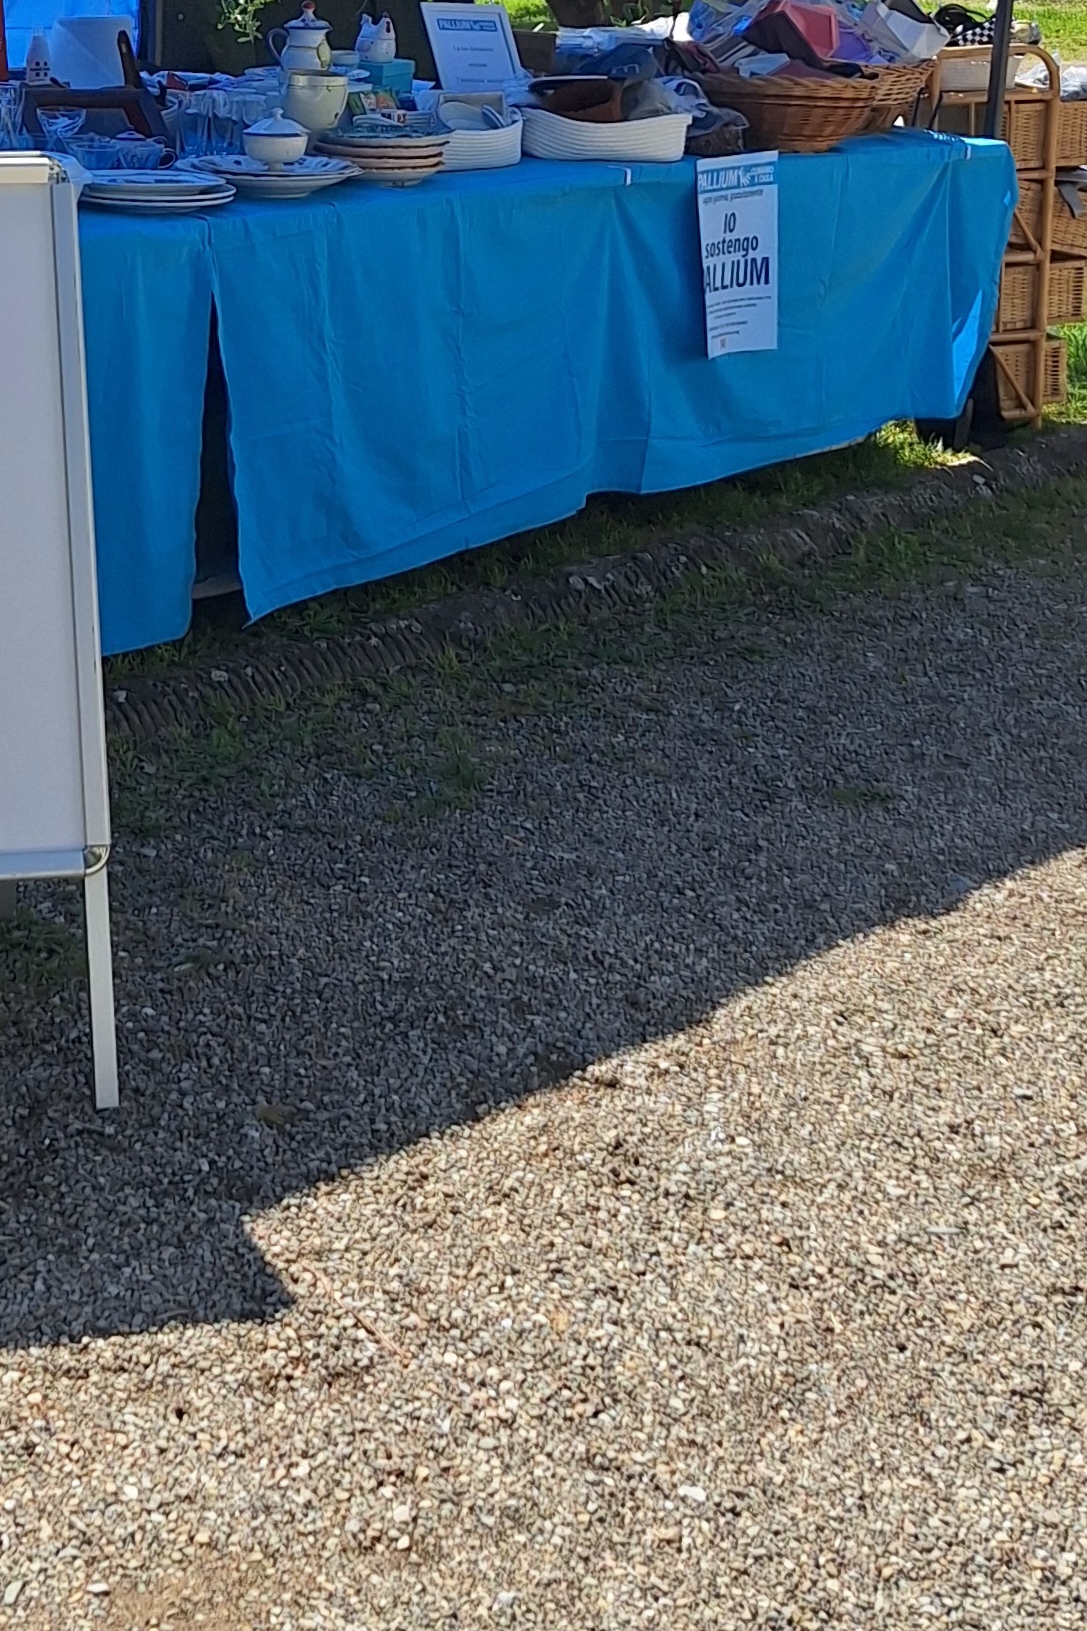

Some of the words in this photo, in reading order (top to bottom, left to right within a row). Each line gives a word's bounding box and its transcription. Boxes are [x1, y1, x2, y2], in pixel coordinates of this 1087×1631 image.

[698, 169, 738, 189] PALLIUM
[723, 212, 736, 234] IO
[705, 235, 759, 259] sostengo
[705, 256, 770, 293] ALLIUM
